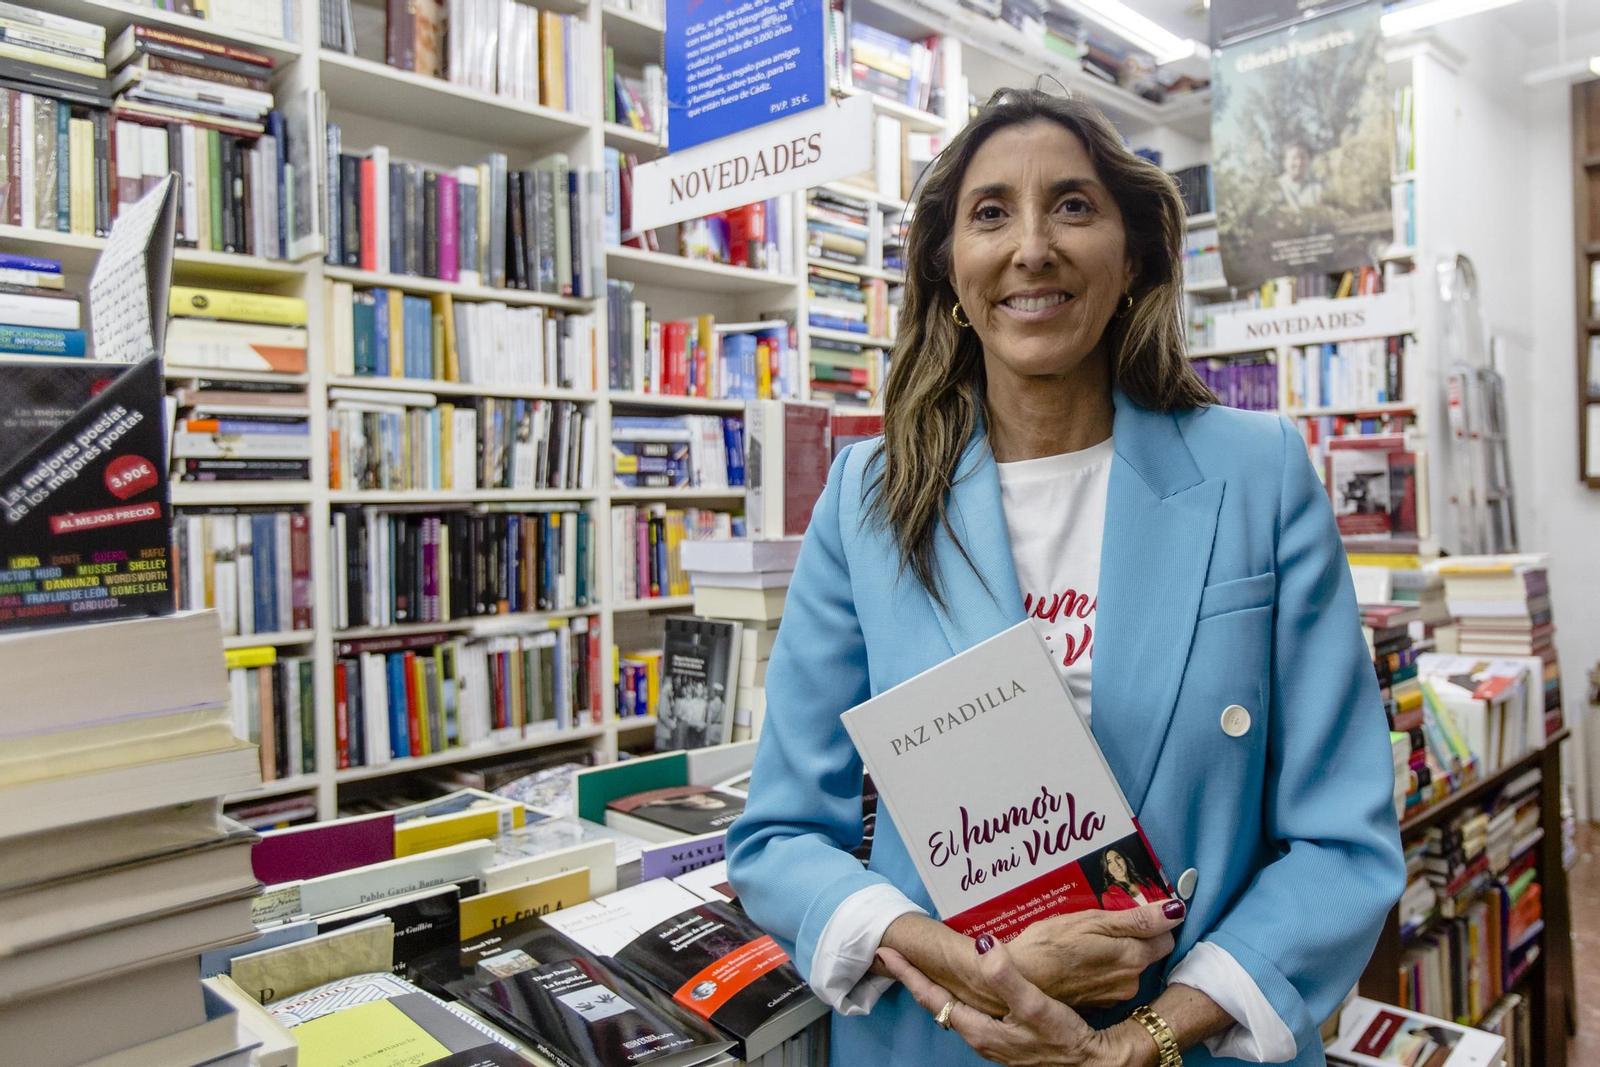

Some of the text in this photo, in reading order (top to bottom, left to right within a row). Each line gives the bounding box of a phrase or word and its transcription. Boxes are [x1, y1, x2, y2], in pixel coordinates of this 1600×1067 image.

[714, 15, 725, 26] pie
[725, 10, 736, 19] de
[685, 38, 700, 48] con
[714, 27, 725, 36] de
[725, 21, 739, 31] 700
[686, 50, 700, 60] nos
[700, 38, 728, 54] muestra
[727, 34, 735, 43] la
[735, 25, 761, 40] belleza
[687, 57, 710, 71] ciudad
[715, 51, 728, 62] sus
[728, 44, 743, 55] más
[743, 40, 753, 49] de
[753, 30, 774, 45] 3.000
[774, 24, 793, 37] años
[687, 85, 698, 94] Un
[732, 63, 755, 78] regalo
[755, 57, 772, 70] para
[773, 47, 801, 63] amigos
[687, 73, 697, 83] de
[687, 98, 693, 108] y
[726, 79, 747, 92] sobre
[767, 66, 784, 79] para
[784, 61, 796, 71] los
[687, 109, 701, 119] que
[702, 101, 721, 112] están
[720, 93, 739, 106] fuera
[740, 90, 749, 100] de
[790, 97, 801, 108] 35
[669, 132, 822, 205] NOVEDADES
[1246, 309, 1366, 338] NOVEDADES
[0, 486, 26, 507] Las
[24, 444, 80, 489] mejores
[9, 410, 144, 521] de los mejores poetas
[59, 507, 156, 529] AL MEJOR PRECIO
[11, 557, 40, 568] LORCA
[35, 567, 62, 579] HUGO
[78, 563, 118, 575] MUSSET
[129, 560, 167, 571] SHELLEY
[105, 571, 168, 585] WORDSWORTH
[27, 592, 50, 604] FRAY
[50, 590, 71, 602] LUIS
[71, 589, 84, 600] DE
[85, 586, 109, 598] LEÓN
[111, 584, 145, 596] GOMES
[146, 582, 168, 593] LEAL
[890, 679, 1027, 756] PAZ PADILLA
[928, 785, 1062, 867] El humor
[961, 857, 988, 892] de
[991, 846, 1022, 878] mi
[360, 878, 444, 903] Pablo García Baena
[972, 923, 986, 934] libro
[1017, 904, 1026, 912] he
[1050, 883, 1071, 897] llorado
[1070, 881, 1078, 889] y,
[994, 921, 1010, 934] todo,
[1009, 918, 1018, 927] he
[1018, 905, 1046, 923] aprendido
[1046, 900, 1058, 910] con
[405, 922, 433, 934] Guillén
[347, 1058, 360, 1066] de
[363, 1038, 417, 1060] resonancia
